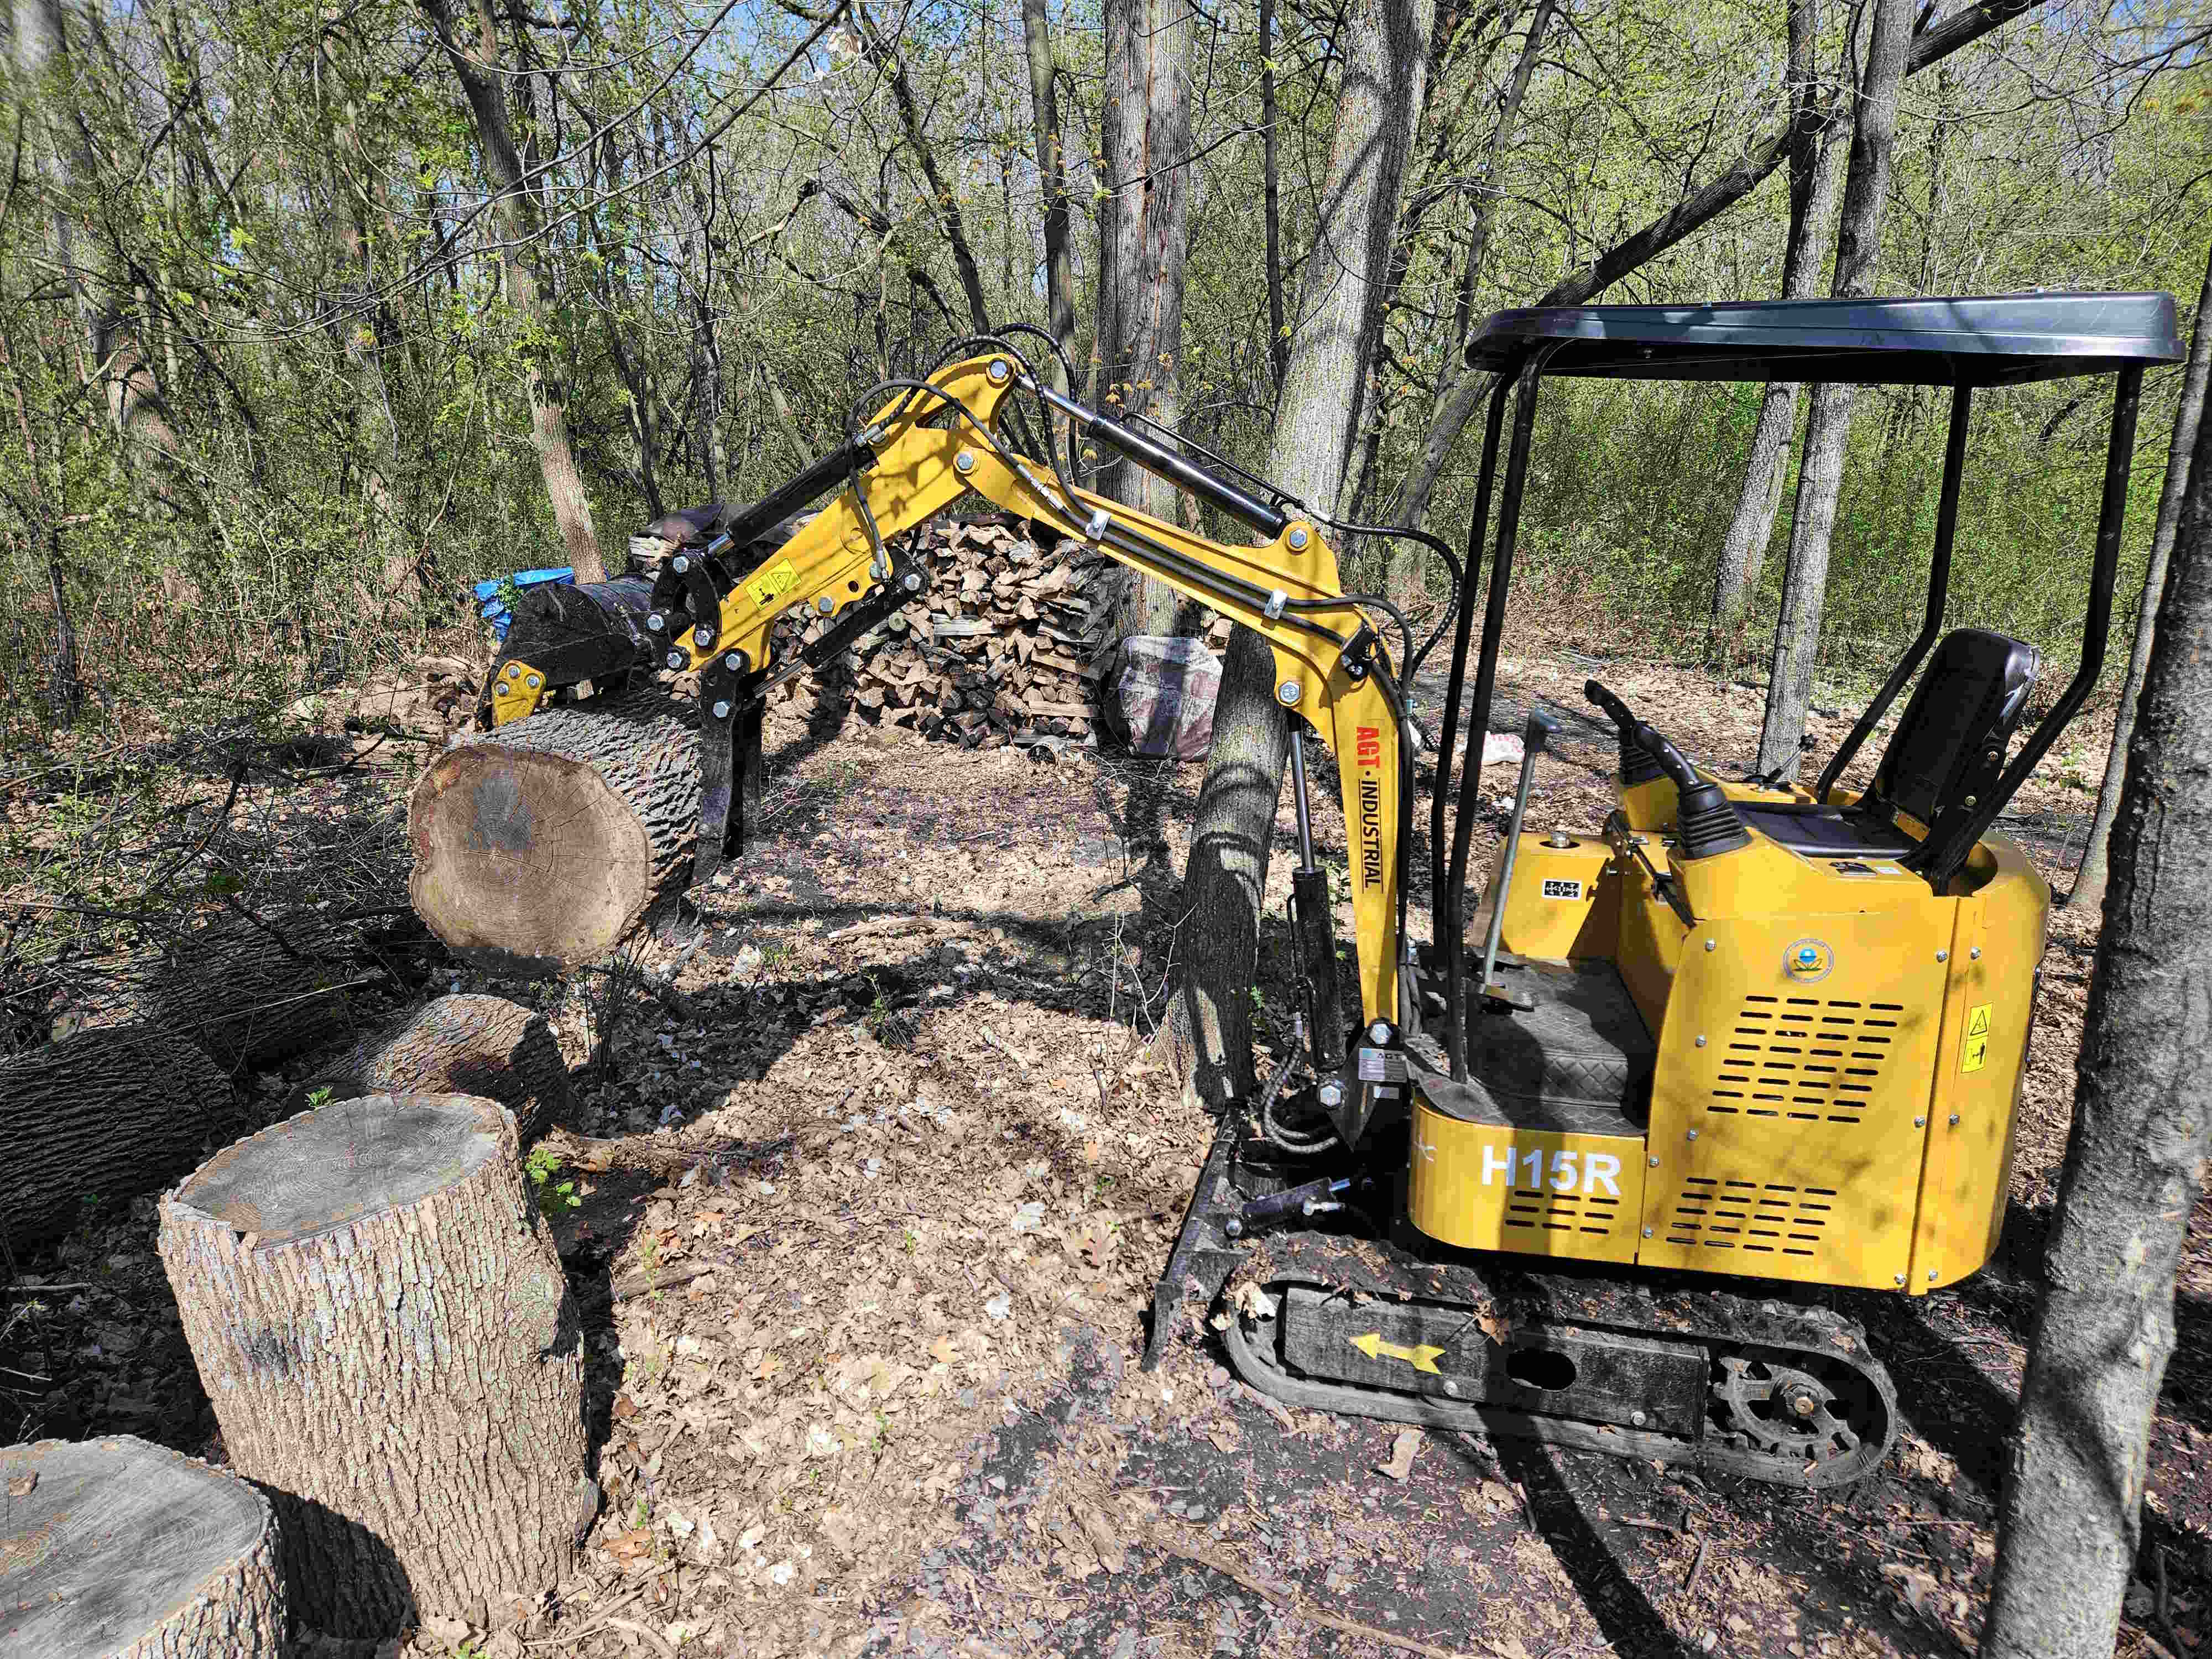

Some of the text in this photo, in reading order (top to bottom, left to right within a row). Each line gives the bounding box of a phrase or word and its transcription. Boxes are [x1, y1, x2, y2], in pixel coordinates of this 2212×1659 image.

[1356, 726, 1380, 888] AGT INDUSTRIAL
[1482, 1145, 1621, 1195] H15R
